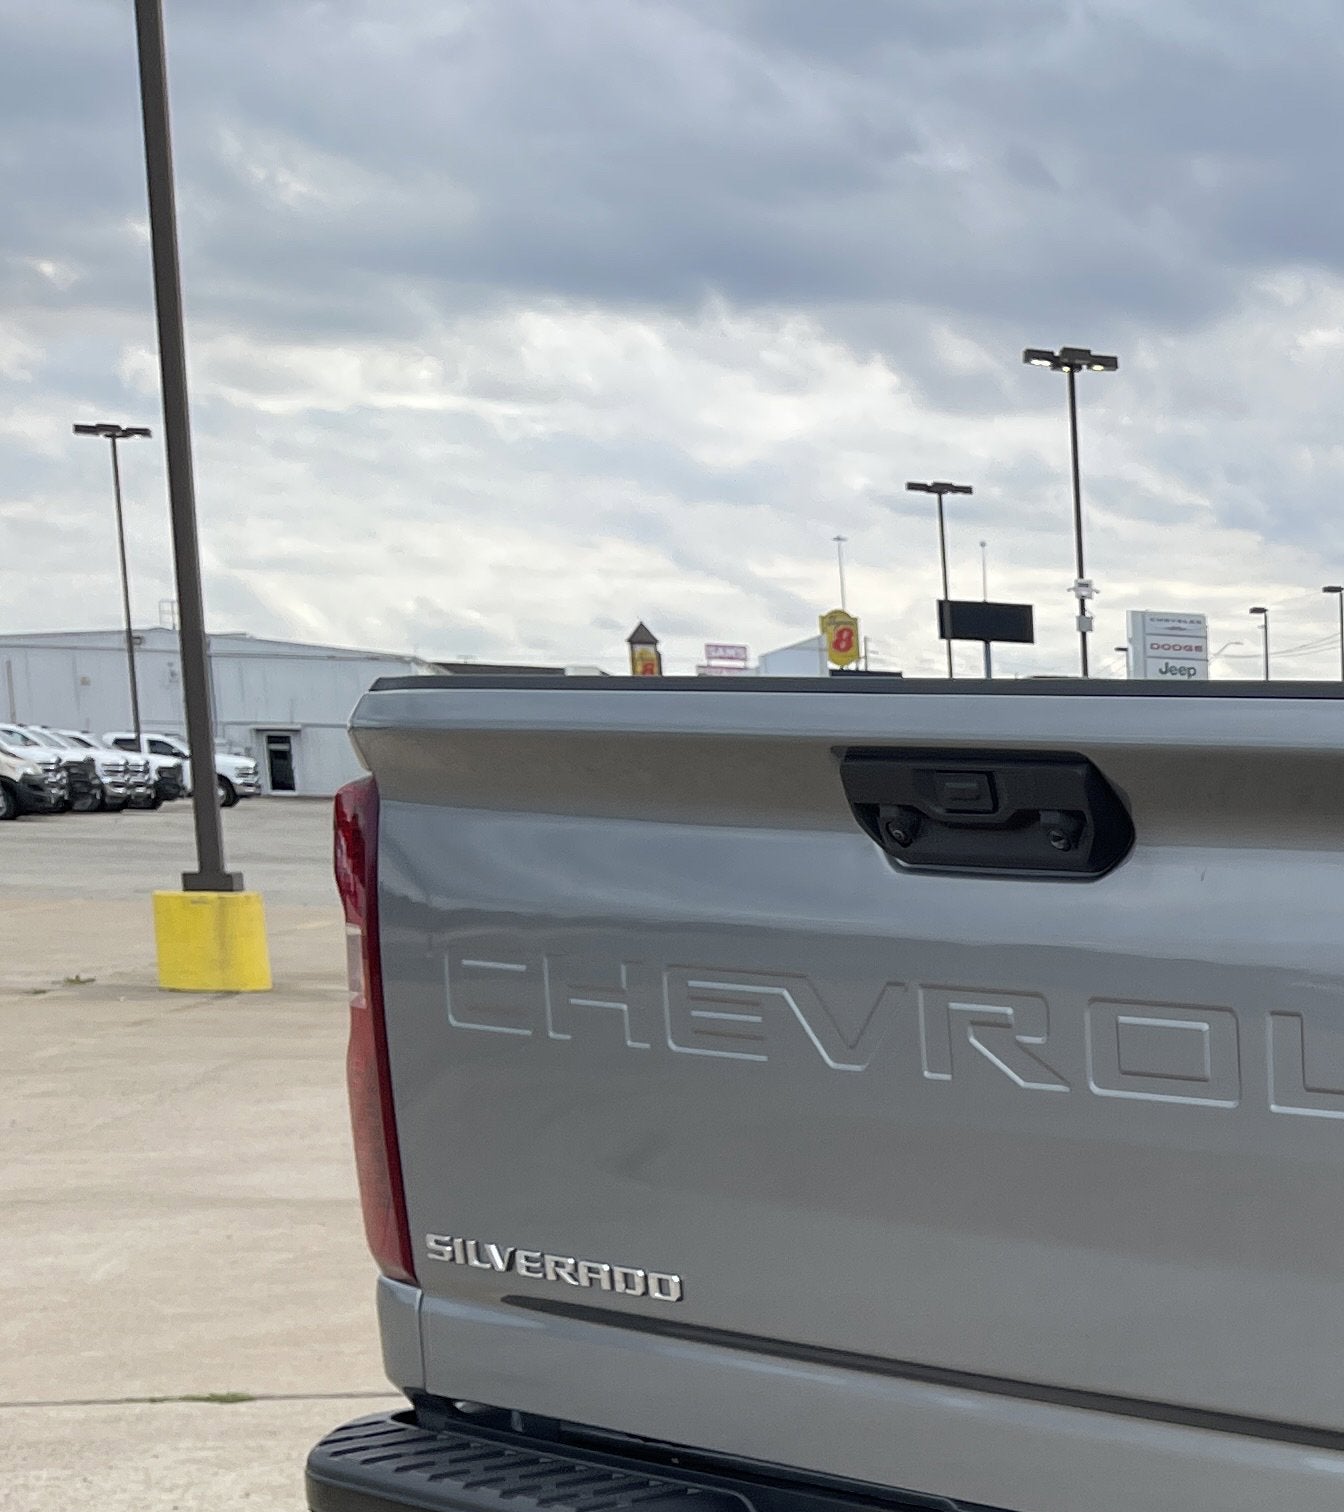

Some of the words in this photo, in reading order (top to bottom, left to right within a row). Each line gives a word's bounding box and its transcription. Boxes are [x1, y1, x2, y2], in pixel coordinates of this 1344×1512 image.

[832, 627, 854, 653] 8
[1158, 662, 1197, 679] Jeep
[424, 1233, 684, 1303] SILVERADO
